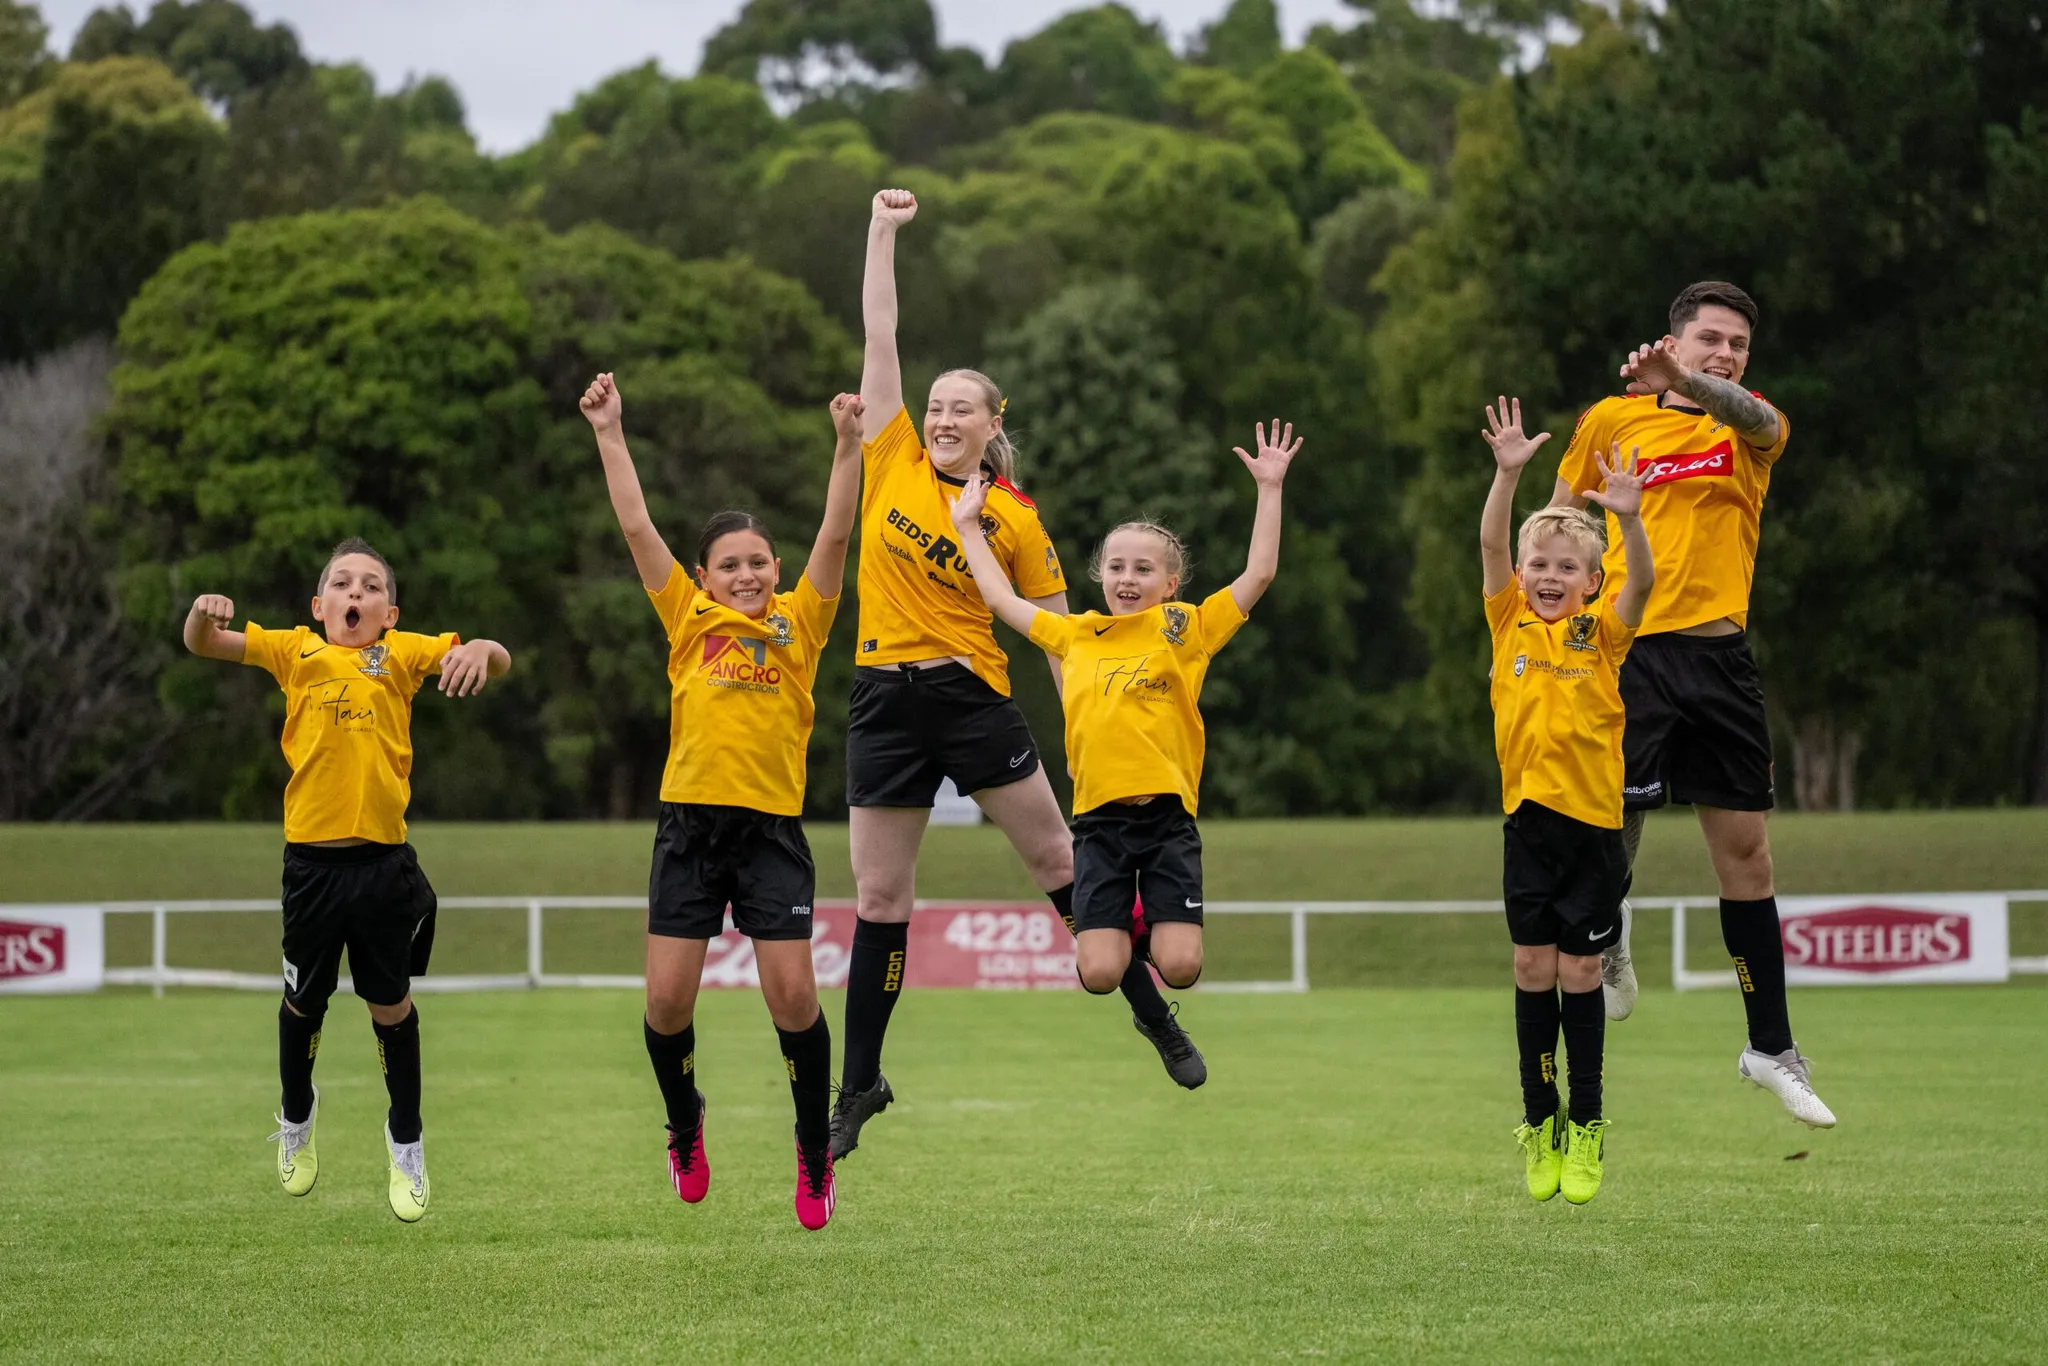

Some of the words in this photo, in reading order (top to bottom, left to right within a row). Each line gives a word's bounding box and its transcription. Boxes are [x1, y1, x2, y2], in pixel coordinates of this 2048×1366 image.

[706, 678, 780, 695] CONSTRUCTIONS
[709, 661, 781, 685] ANCRO
[944, 911, 1054, 952] 4228
[1784, 915, 1961, 965] STEELERS
